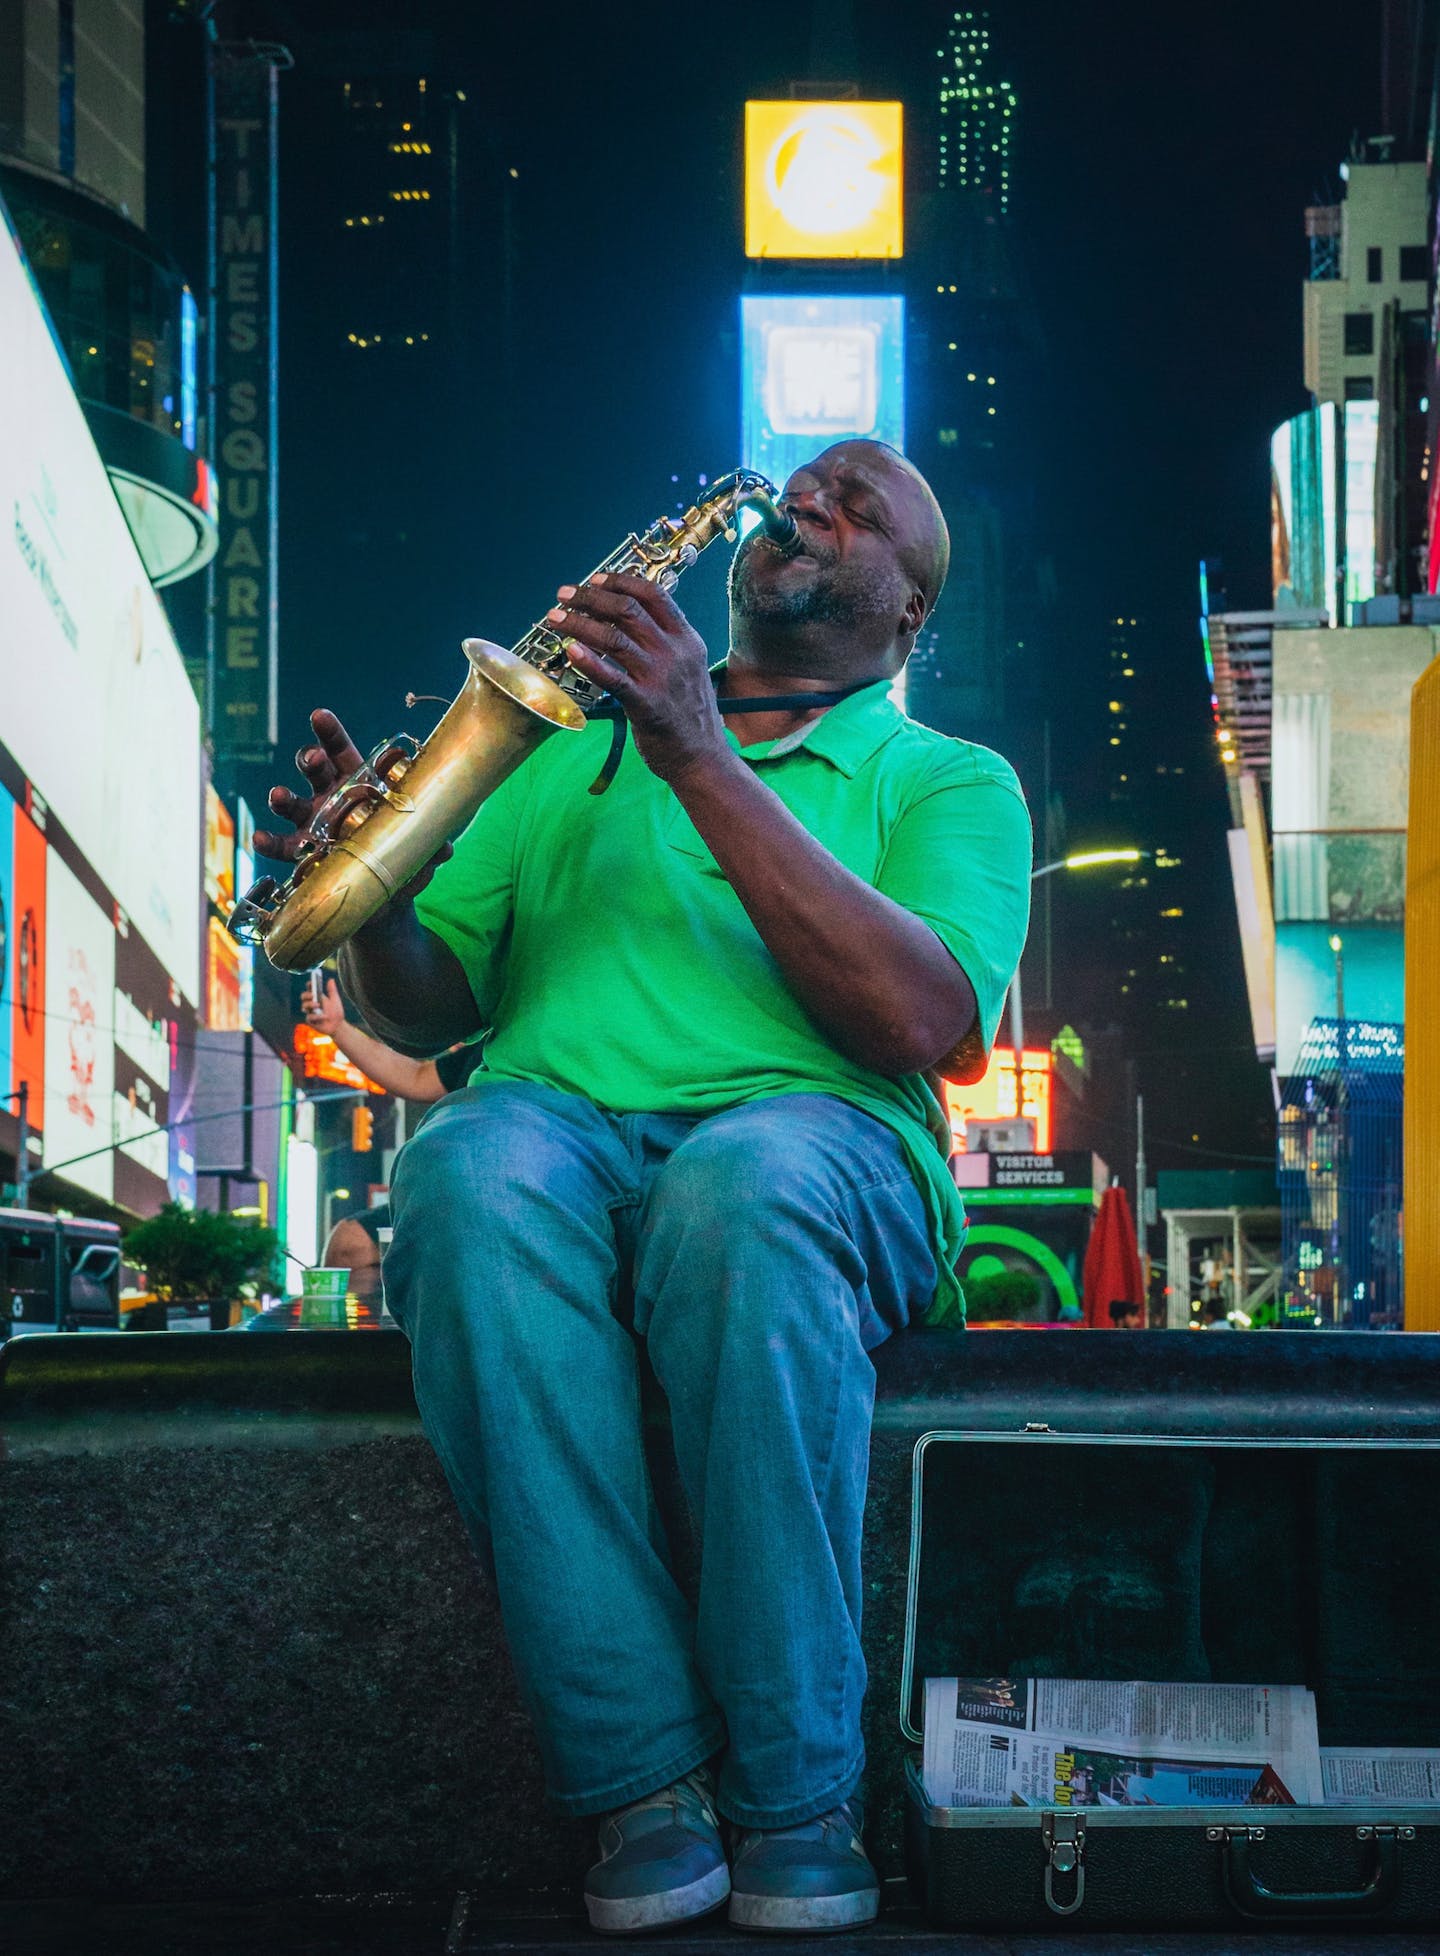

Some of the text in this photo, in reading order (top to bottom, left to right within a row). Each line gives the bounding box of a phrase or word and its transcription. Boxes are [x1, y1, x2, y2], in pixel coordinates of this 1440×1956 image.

[220, 119, 266, 668] TIMES SQUARE
[996, 1155, 1053, 1168] VISITOR
[996, 1171, 1064, 1184] SERVICES
[1054, 1752, 1075, 1781] The
